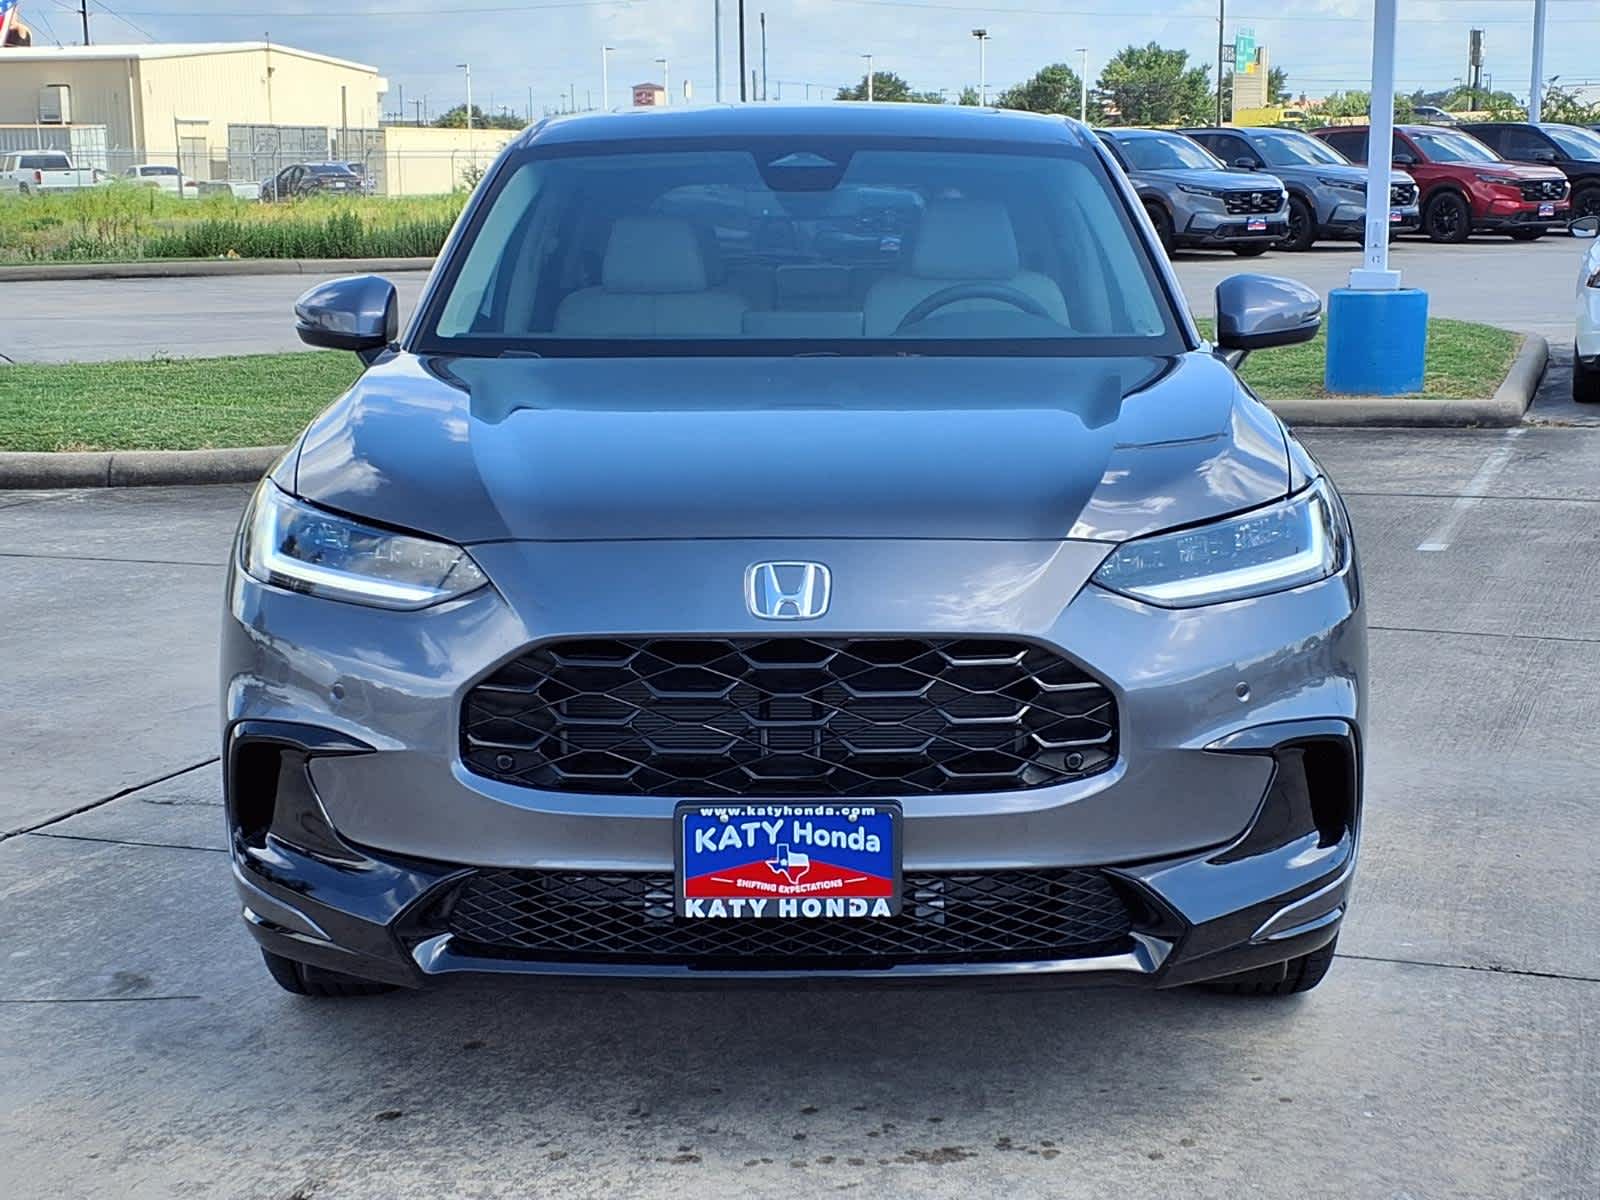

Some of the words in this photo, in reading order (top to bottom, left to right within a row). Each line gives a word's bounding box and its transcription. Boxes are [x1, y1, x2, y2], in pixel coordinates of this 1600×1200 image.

[700, 805, 876, 818] www.katyhonda.com
[695, 819, 784, 853] KATY
[793, 820, 881, 853] Honda
[736, 878, 777, 893] SHIFTING
[778, 878, 843, 895] EXPECTATIONS
[684, 898, 768, 918] KATY
[779, 898, 892, 918] HONDA
